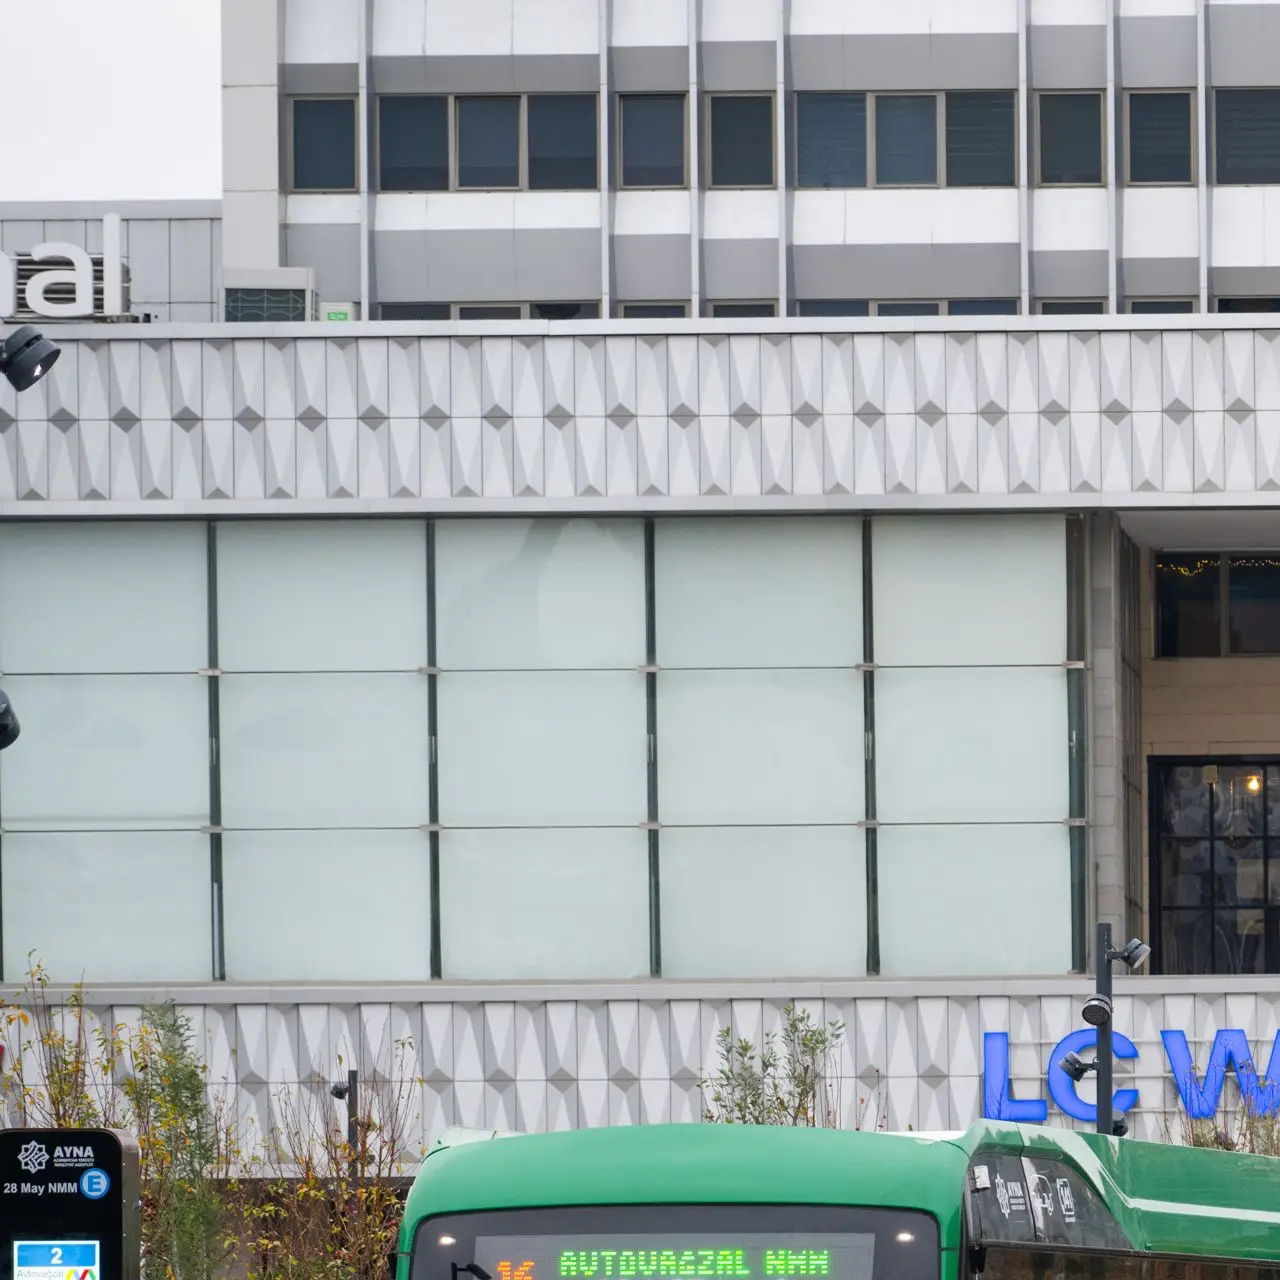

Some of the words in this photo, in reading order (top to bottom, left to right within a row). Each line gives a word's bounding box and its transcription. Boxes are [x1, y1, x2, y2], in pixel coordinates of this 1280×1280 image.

[983, 1027, 1140, 1122] LC
[53, 1146, 95, 1158] AYNA
[3, 1183, 18, 1194] 28
[20, 1183, 45, 1197] May
[48, 1183, 78, 1194] NMM
[87, 1175, 102, 1193] E
[50, 1247, 63, 1265] 2
[764, 1250, 829, 1276] NMM
